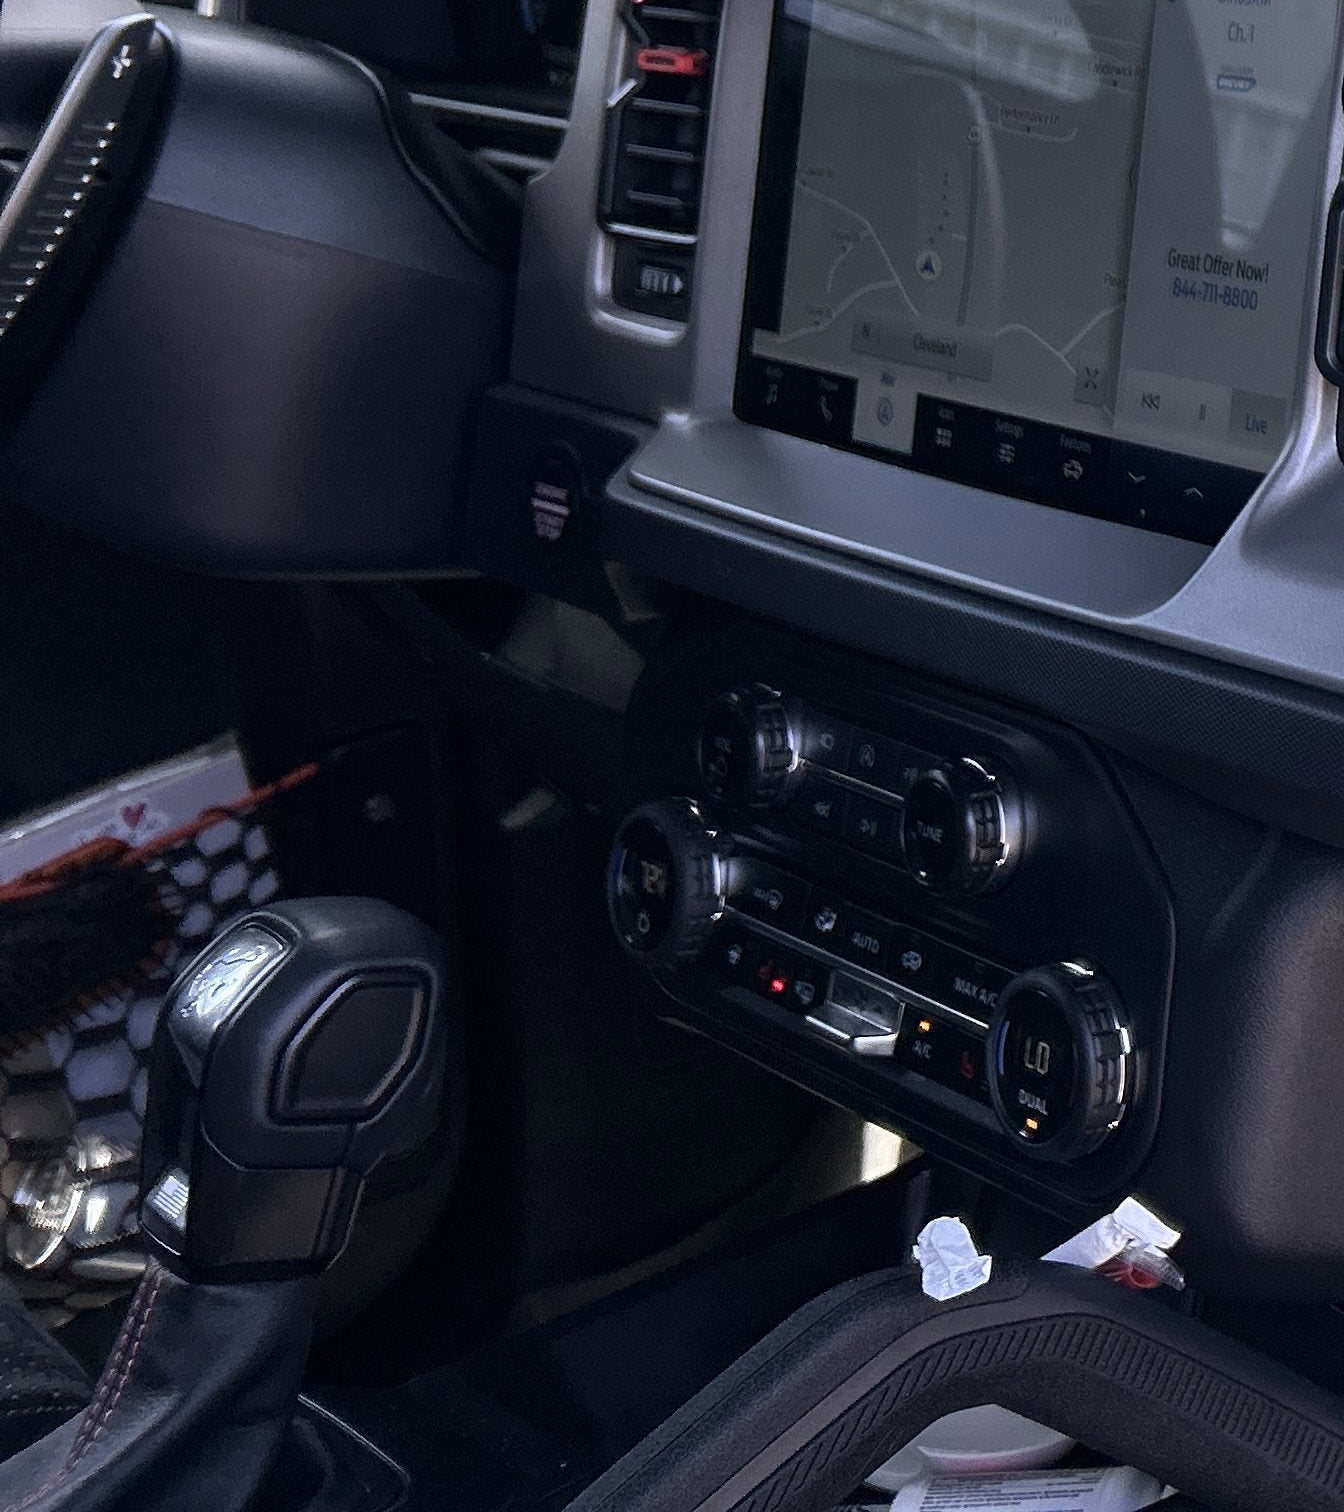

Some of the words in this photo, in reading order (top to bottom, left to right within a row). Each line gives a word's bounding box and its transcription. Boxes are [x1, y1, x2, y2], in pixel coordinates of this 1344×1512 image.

[1167, 247, 1201, 272] Great
[1203, 253, 1235, 278] Offer
[1236, 259, 1270, 284] Now!
[1172, 276, 1259, 310] 844-711-8800
[1244, 413, 1269, 435] Live
[852, 931, 880, 955] AUTO
[953, 976, 979, 998] MAX
[1017, 1088, 1049, 1116] DUAL
